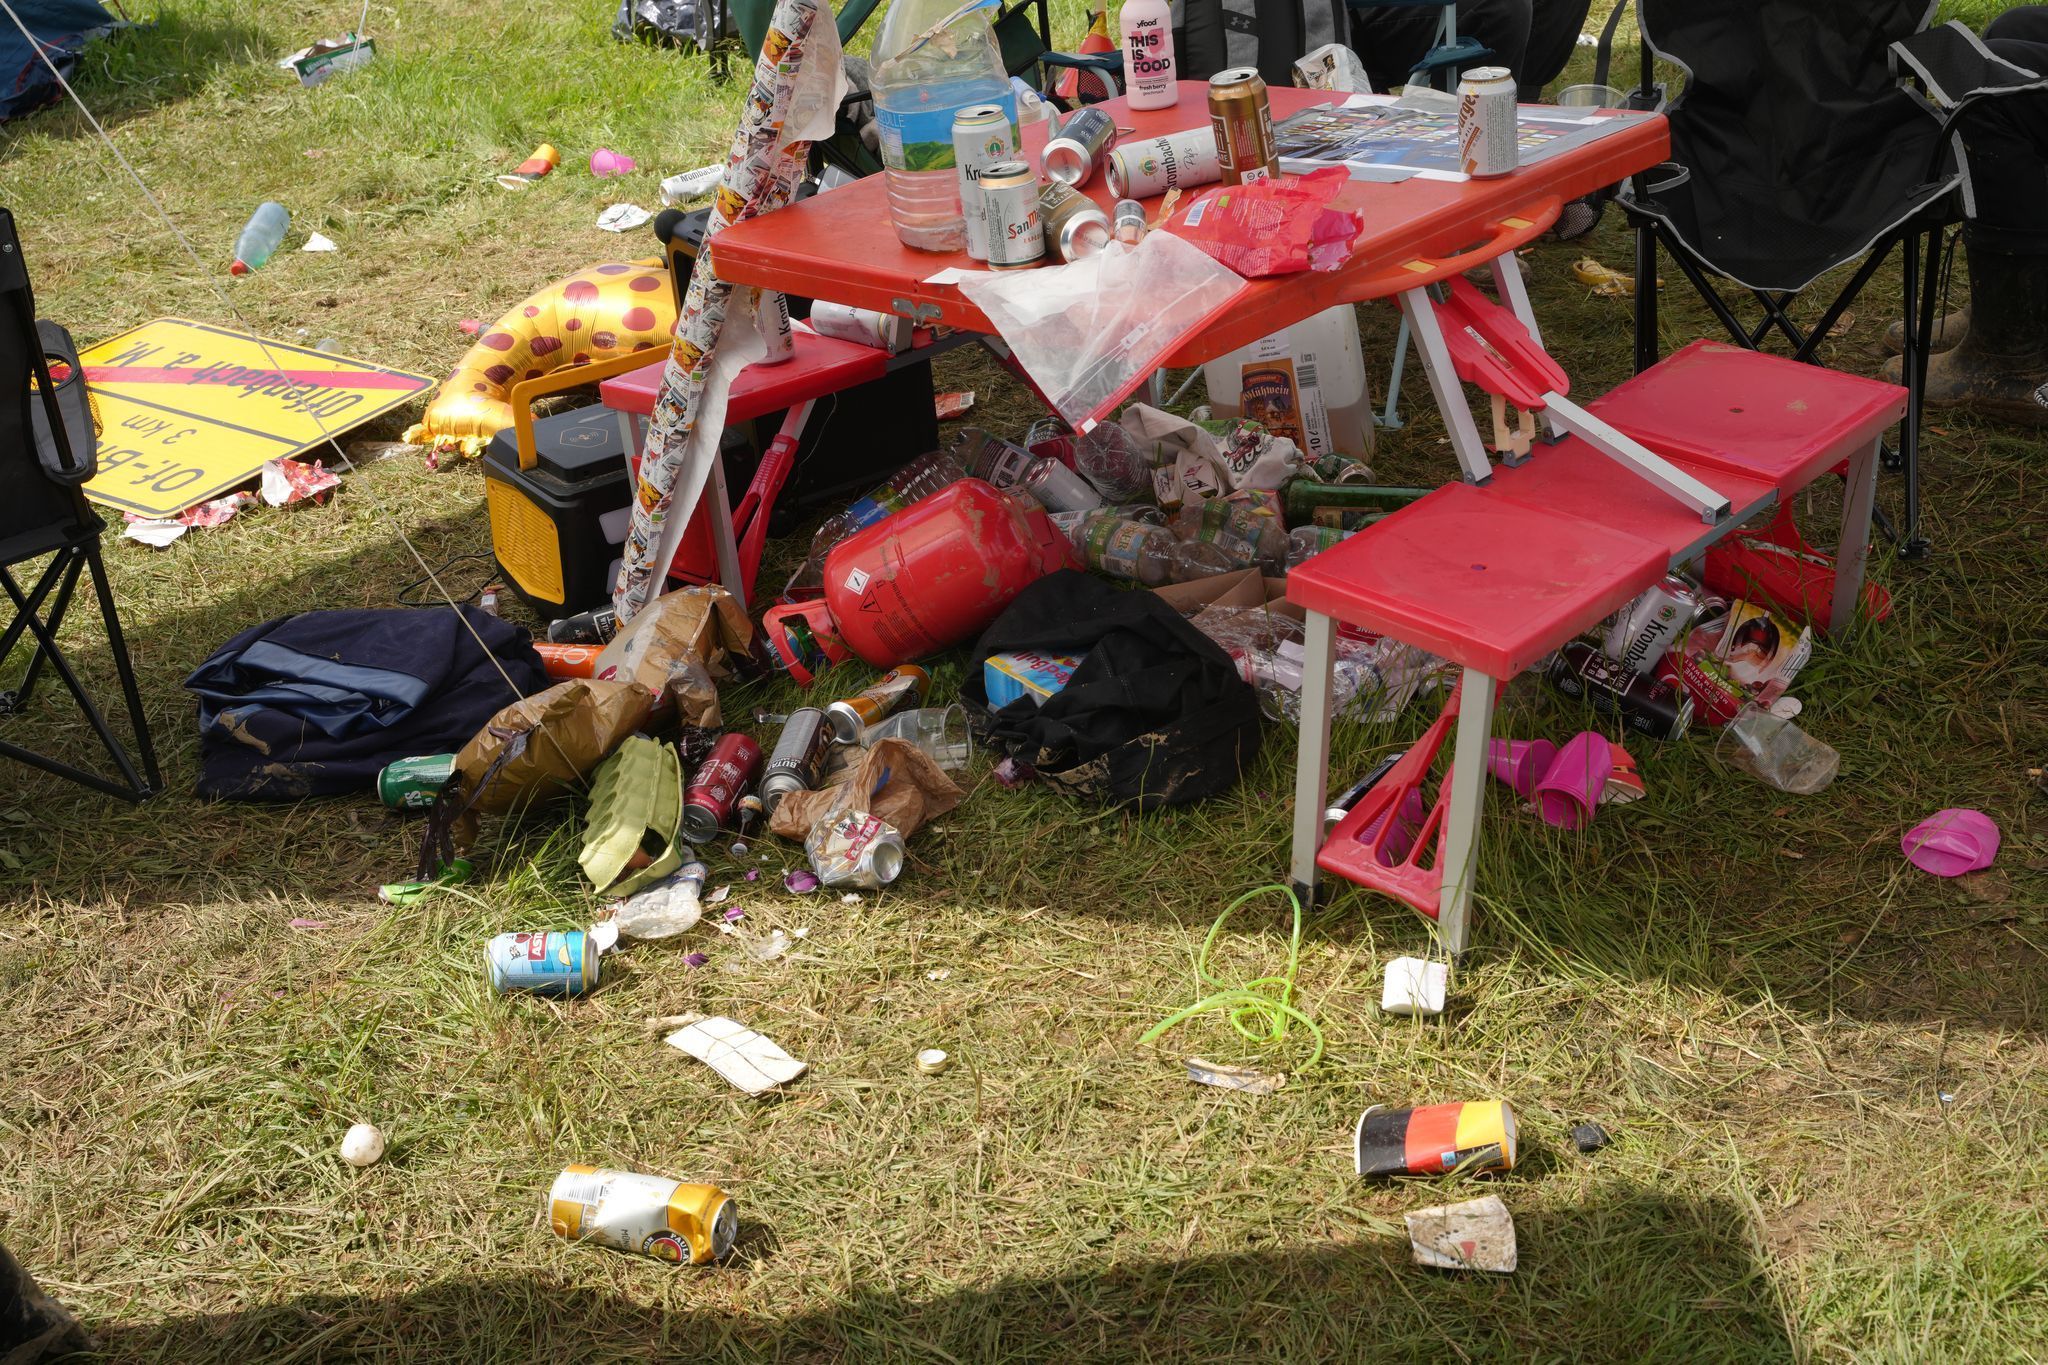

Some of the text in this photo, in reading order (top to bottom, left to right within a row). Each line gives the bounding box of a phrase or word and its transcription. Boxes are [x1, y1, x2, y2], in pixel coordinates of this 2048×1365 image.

[1136, 18, 1157, 28] yfood
[1129, 34, 1158, 47] THIS
[1132, 49, 1144, 60] IS
[1134, 58, 1170, 73] FOOD
[103, 341, 363, 420] Offenbach a. M.
[120, 414, 198, 445] 3 km
[1310, 437, 1322, 451] 10
[1684, 667, 1704, 689] WINE
[1703, 679, 1729, 705] MEDUM
